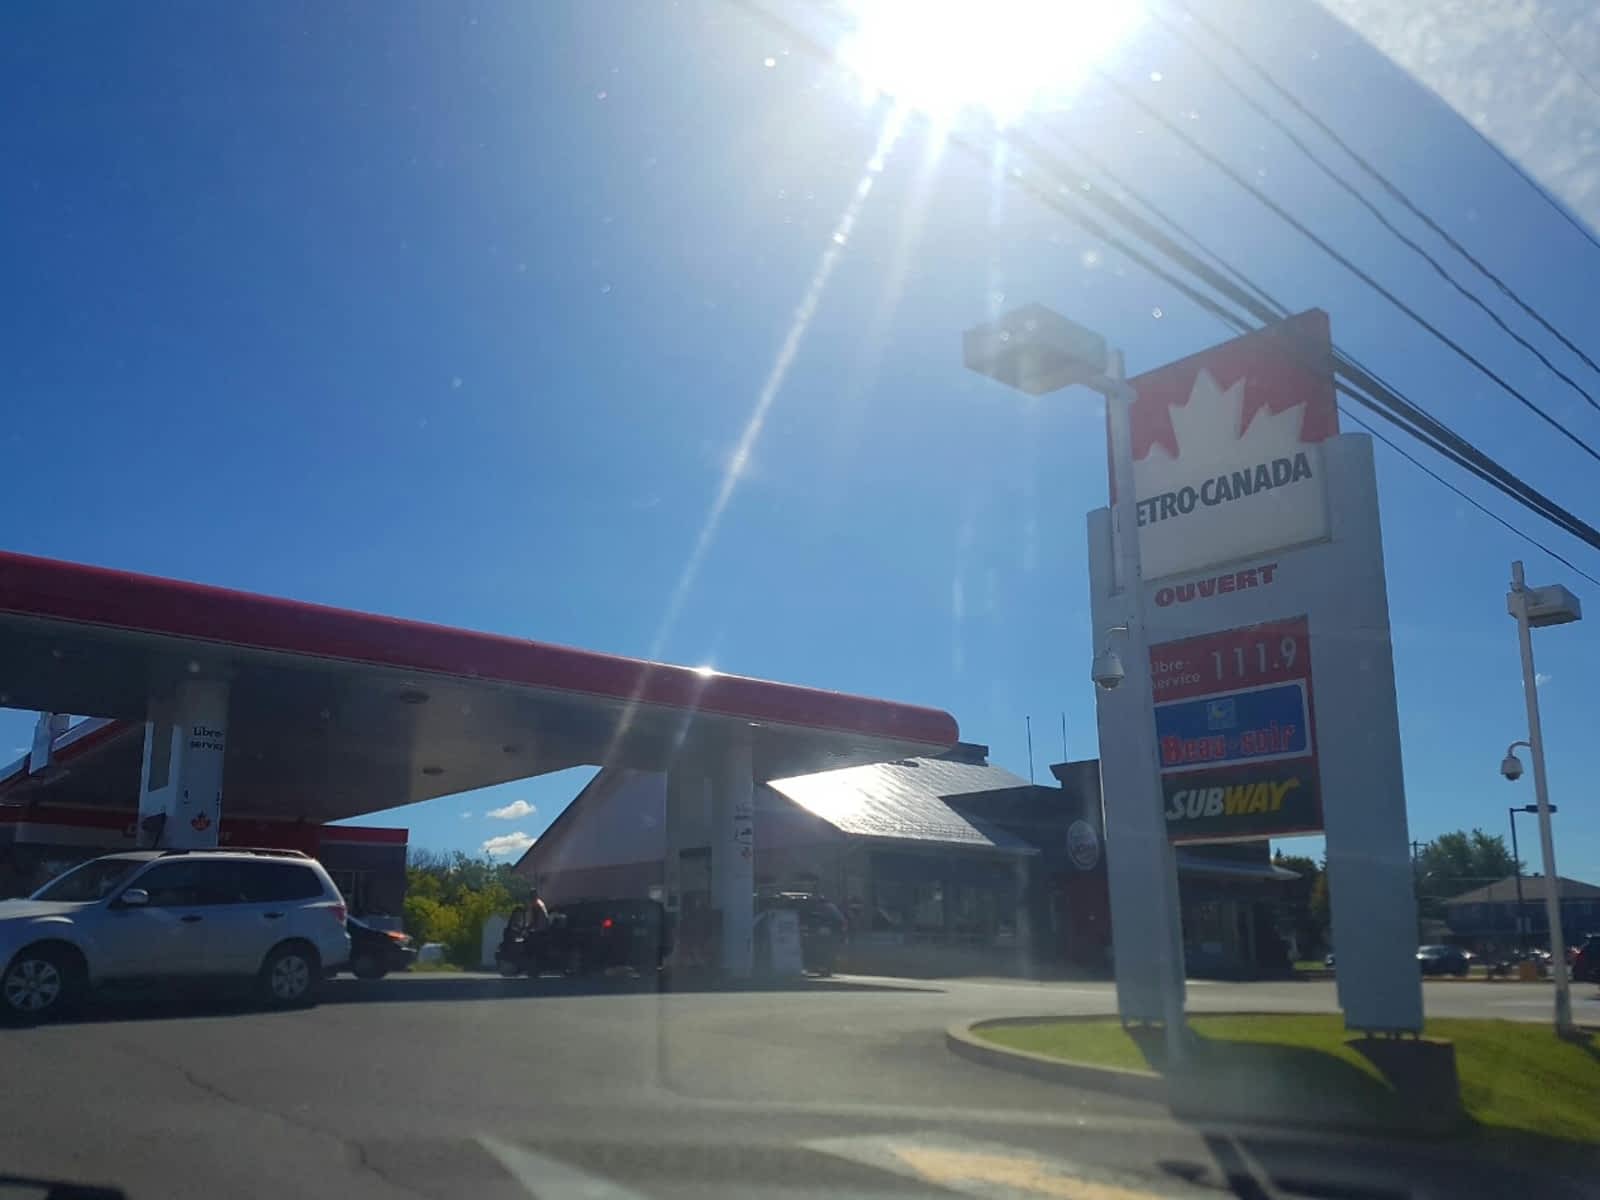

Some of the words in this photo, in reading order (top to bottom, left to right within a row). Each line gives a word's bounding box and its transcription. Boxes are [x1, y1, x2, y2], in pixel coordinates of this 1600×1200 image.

[1136, 452, 1312, 527] ETRO-CANADA
[1155, 563, 1278, 607] OUVERT
[1211, 636, 1297, 680] 111.9
[1165, 776, 1301, 820] SUBWAY
